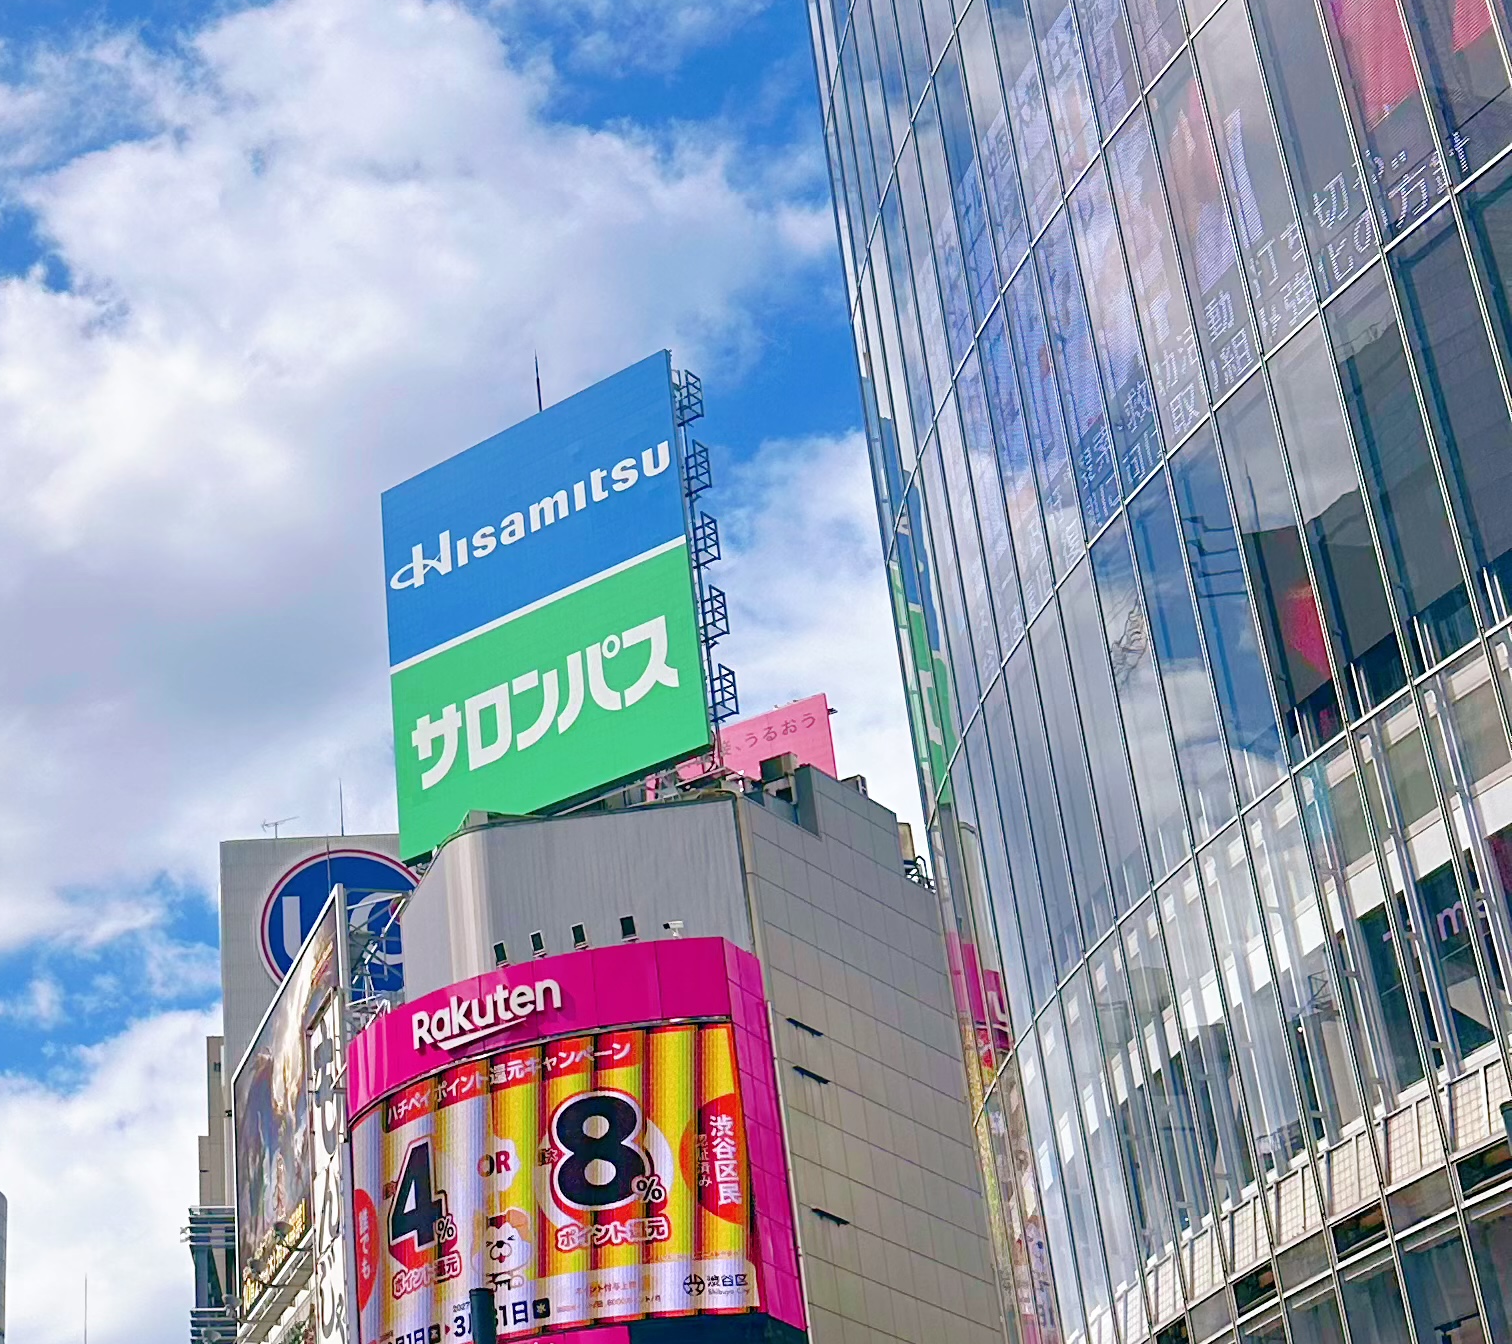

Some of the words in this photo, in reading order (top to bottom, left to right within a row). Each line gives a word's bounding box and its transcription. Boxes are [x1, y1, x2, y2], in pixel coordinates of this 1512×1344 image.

[390, 439, 672, 590] Hisamitsu
[412, 615, 679, 790] サロンパス
[411, 976, 563, 1052] Rakuten
[478, 1149, 512, 1178] OR
[709, 1114, 742, 1205] 渋谷区民
[706, 1273, 749, 1288] 渋谷区
